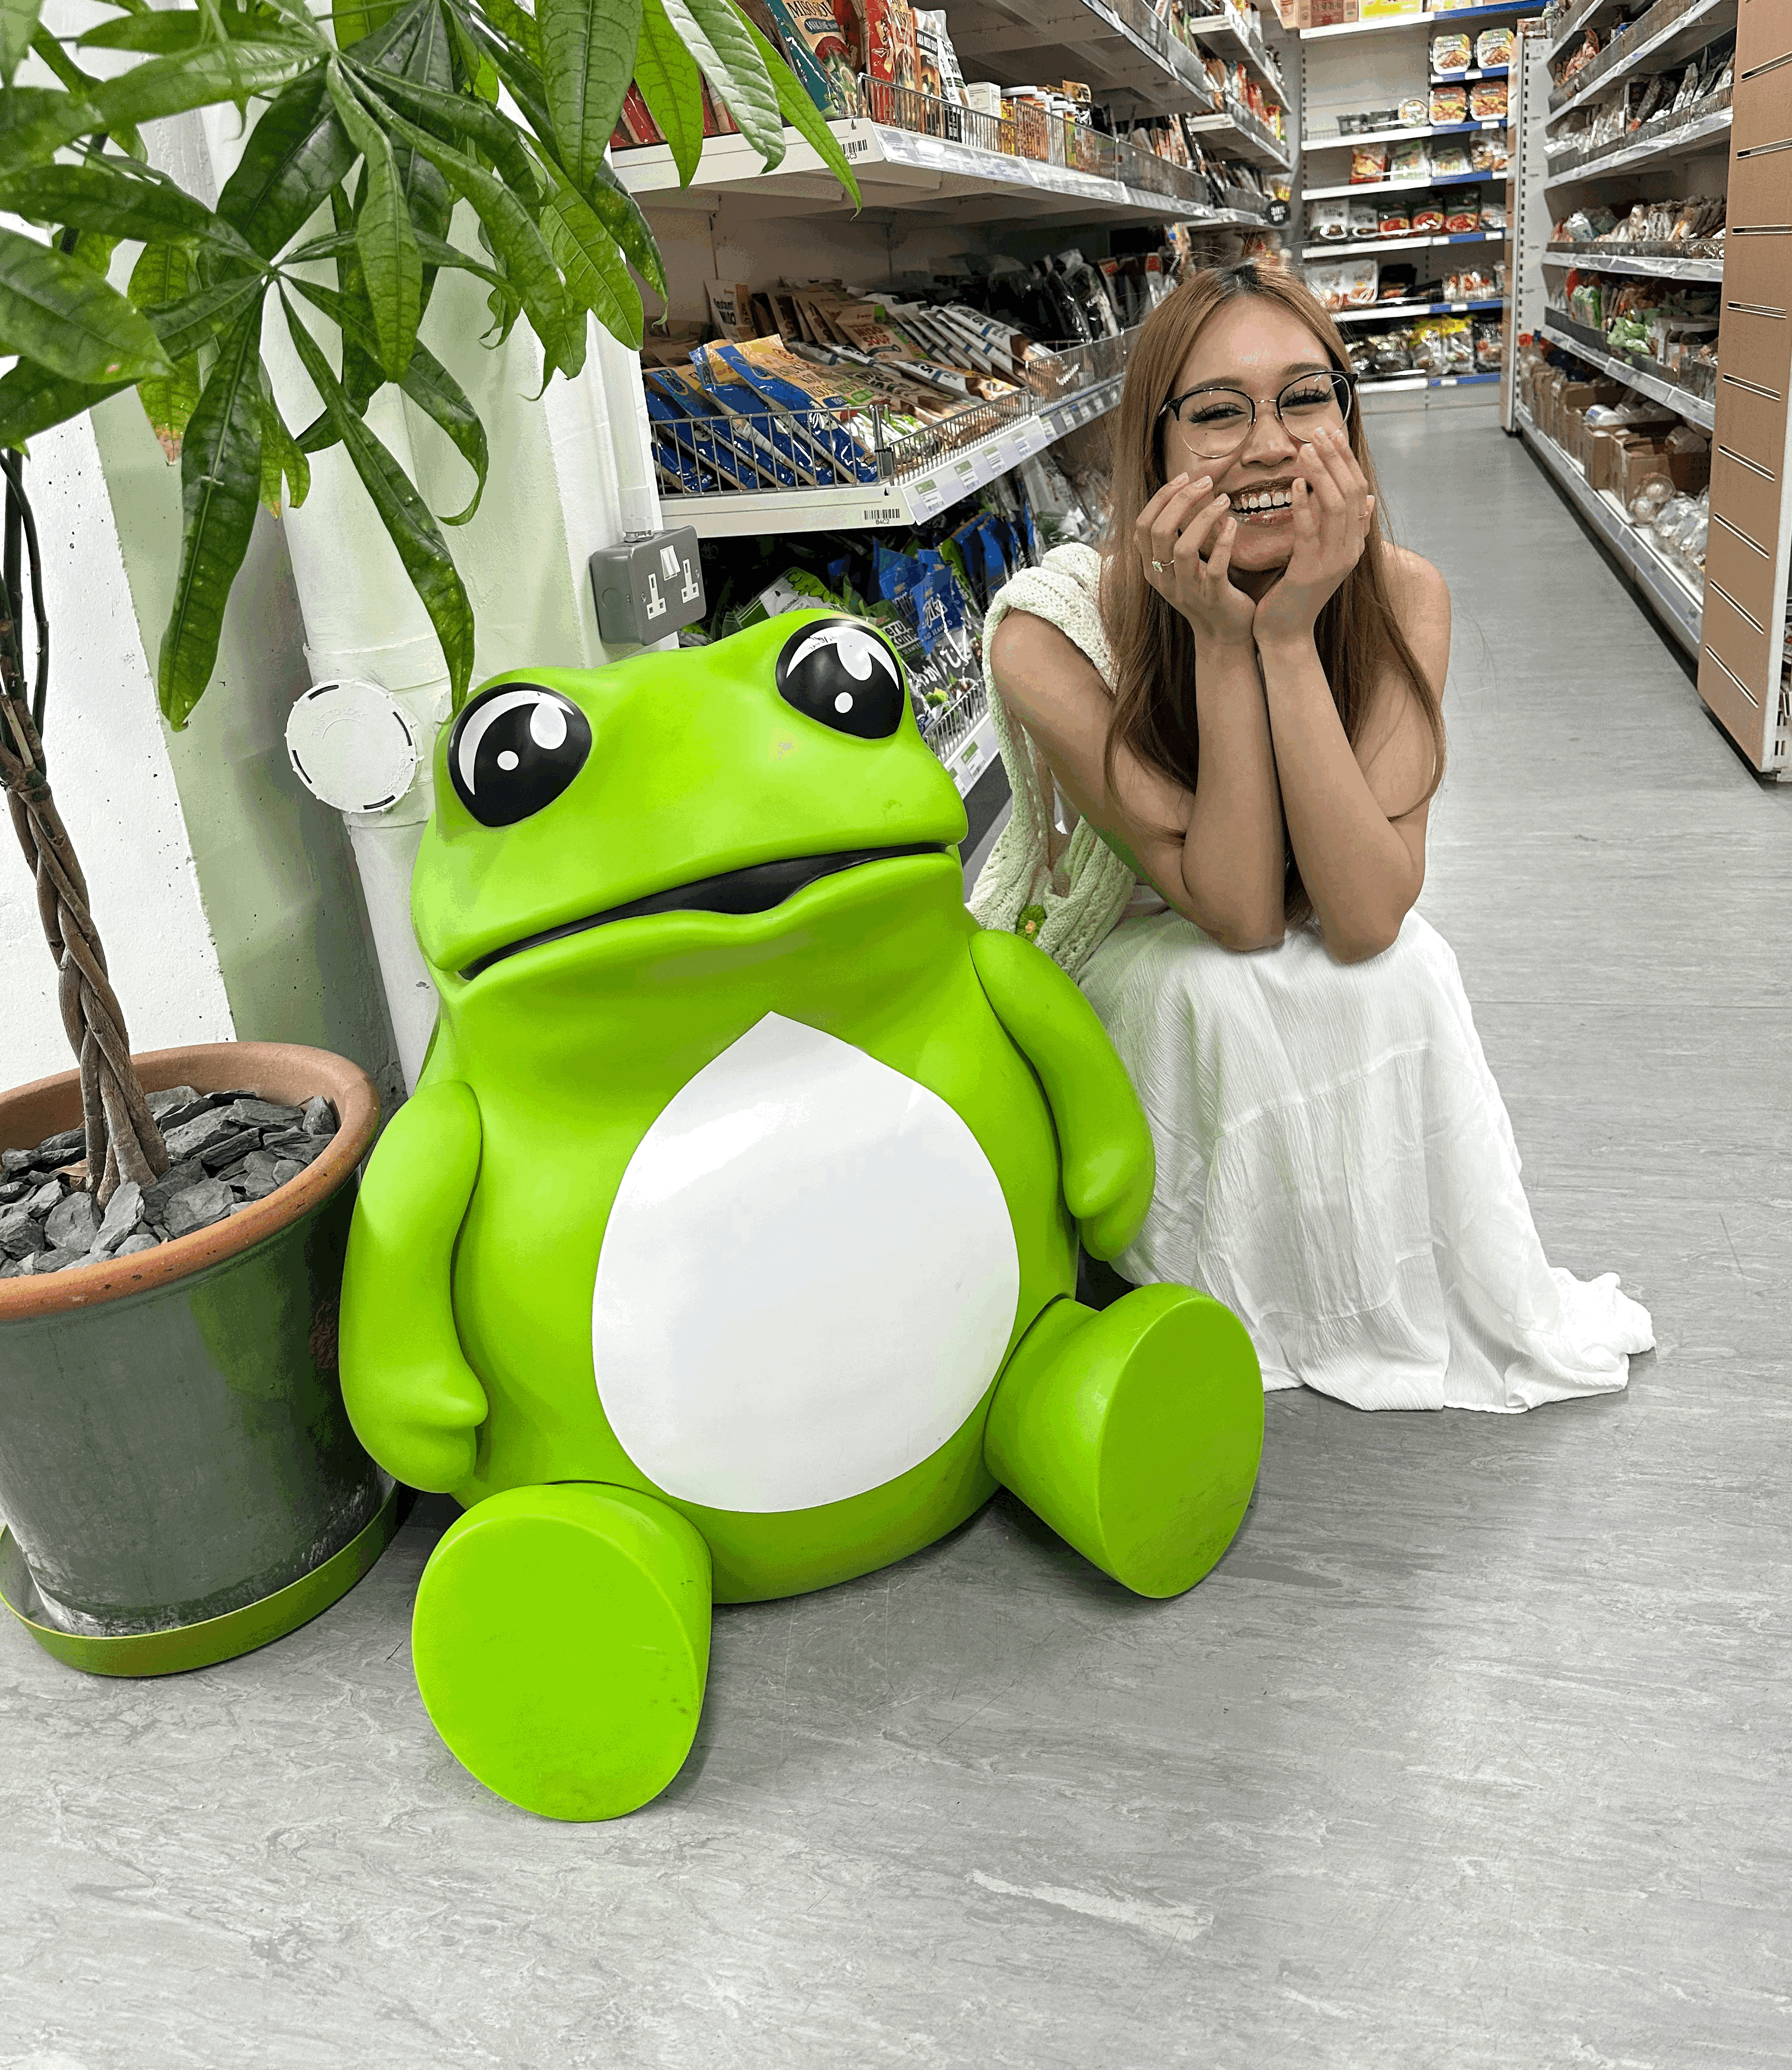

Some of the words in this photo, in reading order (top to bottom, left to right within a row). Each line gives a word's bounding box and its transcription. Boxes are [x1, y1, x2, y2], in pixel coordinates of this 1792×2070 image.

[787, 1, 816, 18] MISO
[813, 1, 834, 17] SOU
[863, 335, 891, 346] SOUP
